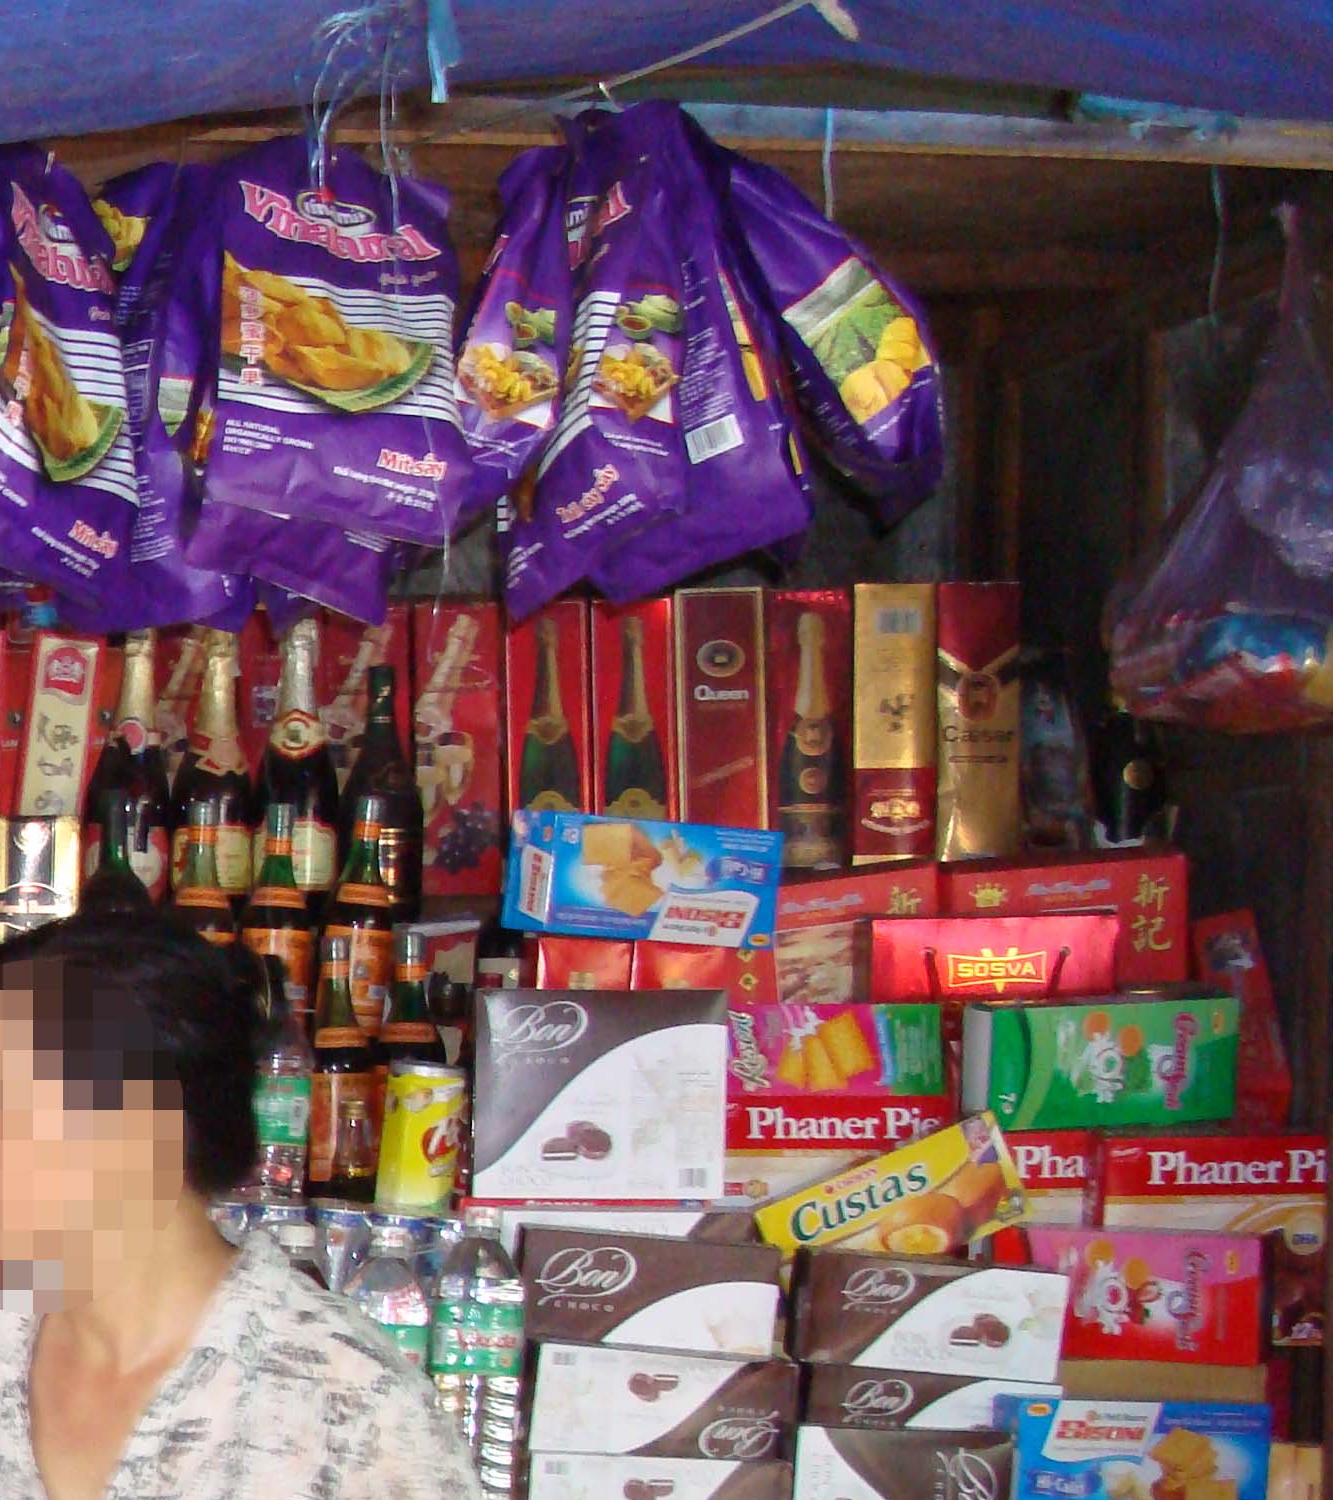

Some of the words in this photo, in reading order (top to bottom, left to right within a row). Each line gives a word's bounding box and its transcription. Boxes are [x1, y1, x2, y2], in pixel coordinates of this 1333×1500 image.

[693, 684, 750, 702] Queen
[1130, 872, 1173, 954] 新記
[956, 960, 1037, 979] SOSVA
[745, 1106, 881, 1140] Phaner
[1146, 1151, 1284, 1186] Phaner
[790, 1163, 930, 1243] Custas
[535, 1246, 637, 1304] Bon
[841, 1266, 916, 1305] Bon
[841, 1378, 915, 1417] Bon
